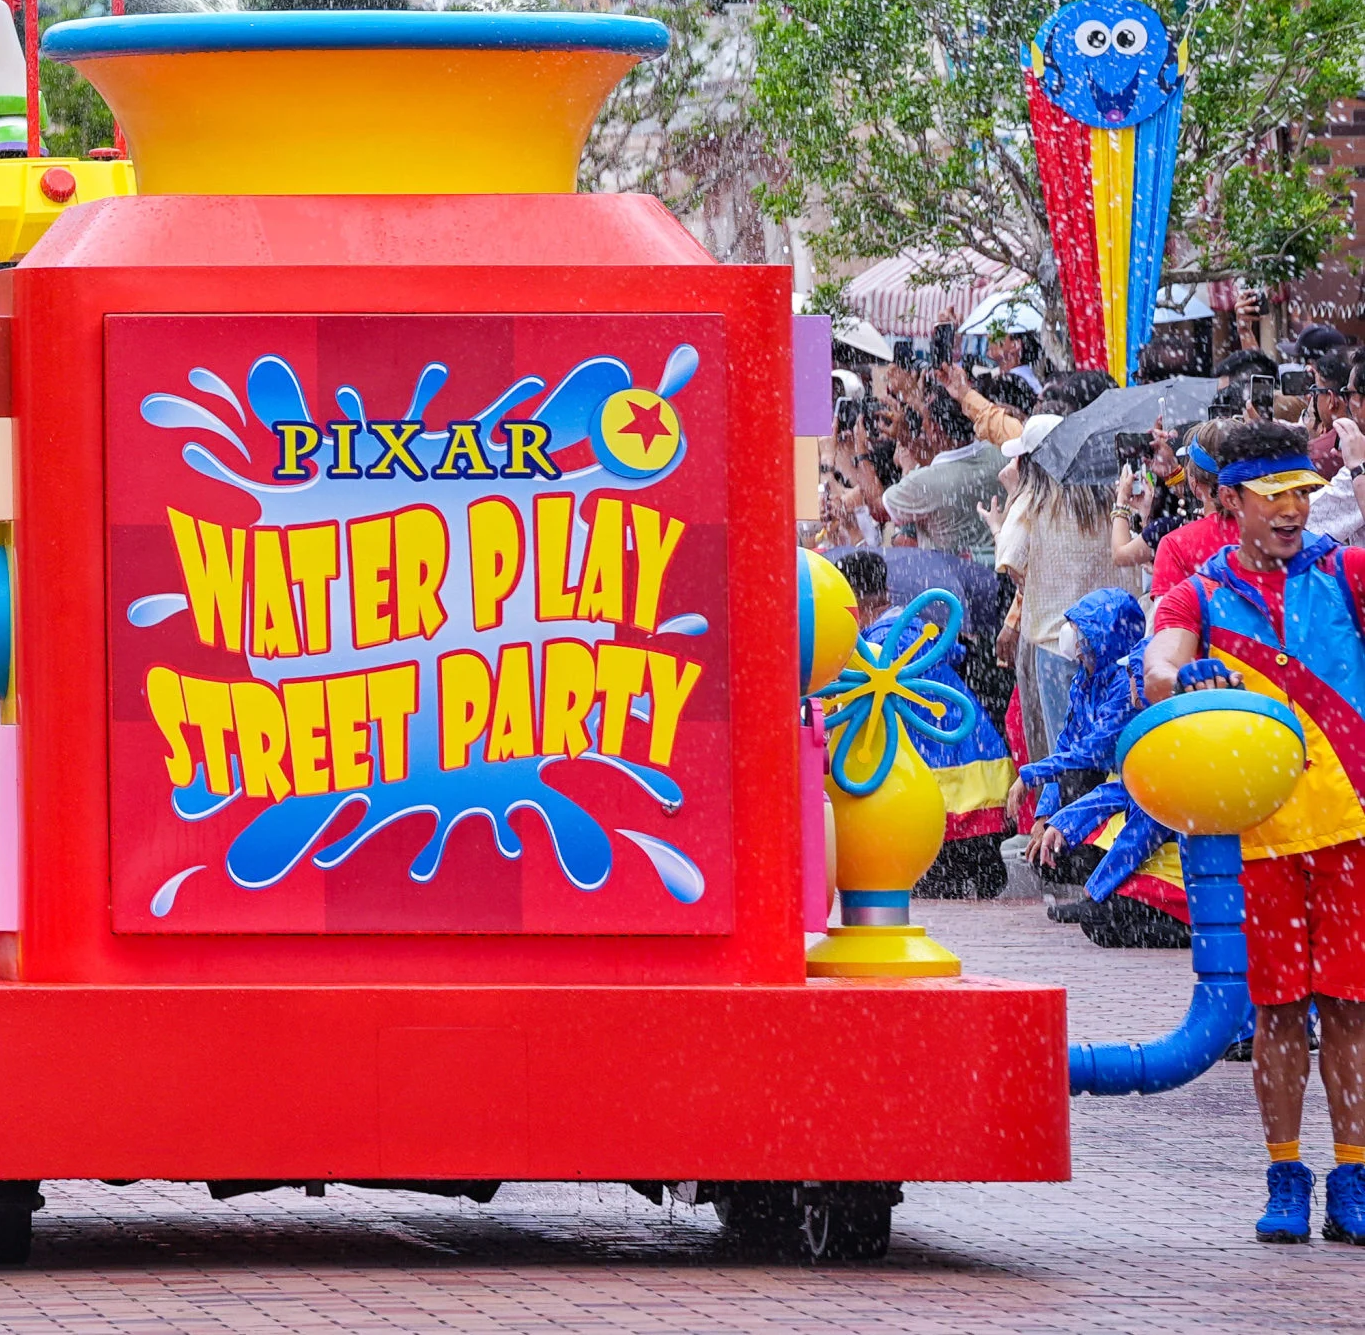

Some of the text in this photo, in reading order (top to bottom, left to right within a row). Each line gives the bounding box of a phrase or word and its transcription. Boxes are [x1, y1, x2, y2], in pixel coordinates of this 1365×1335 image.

[274, 420, 560, 479] PIXAR
[167, 492, 686, 659] WATER PLAY
[145, 638, 702, 803] STREET PARTY
